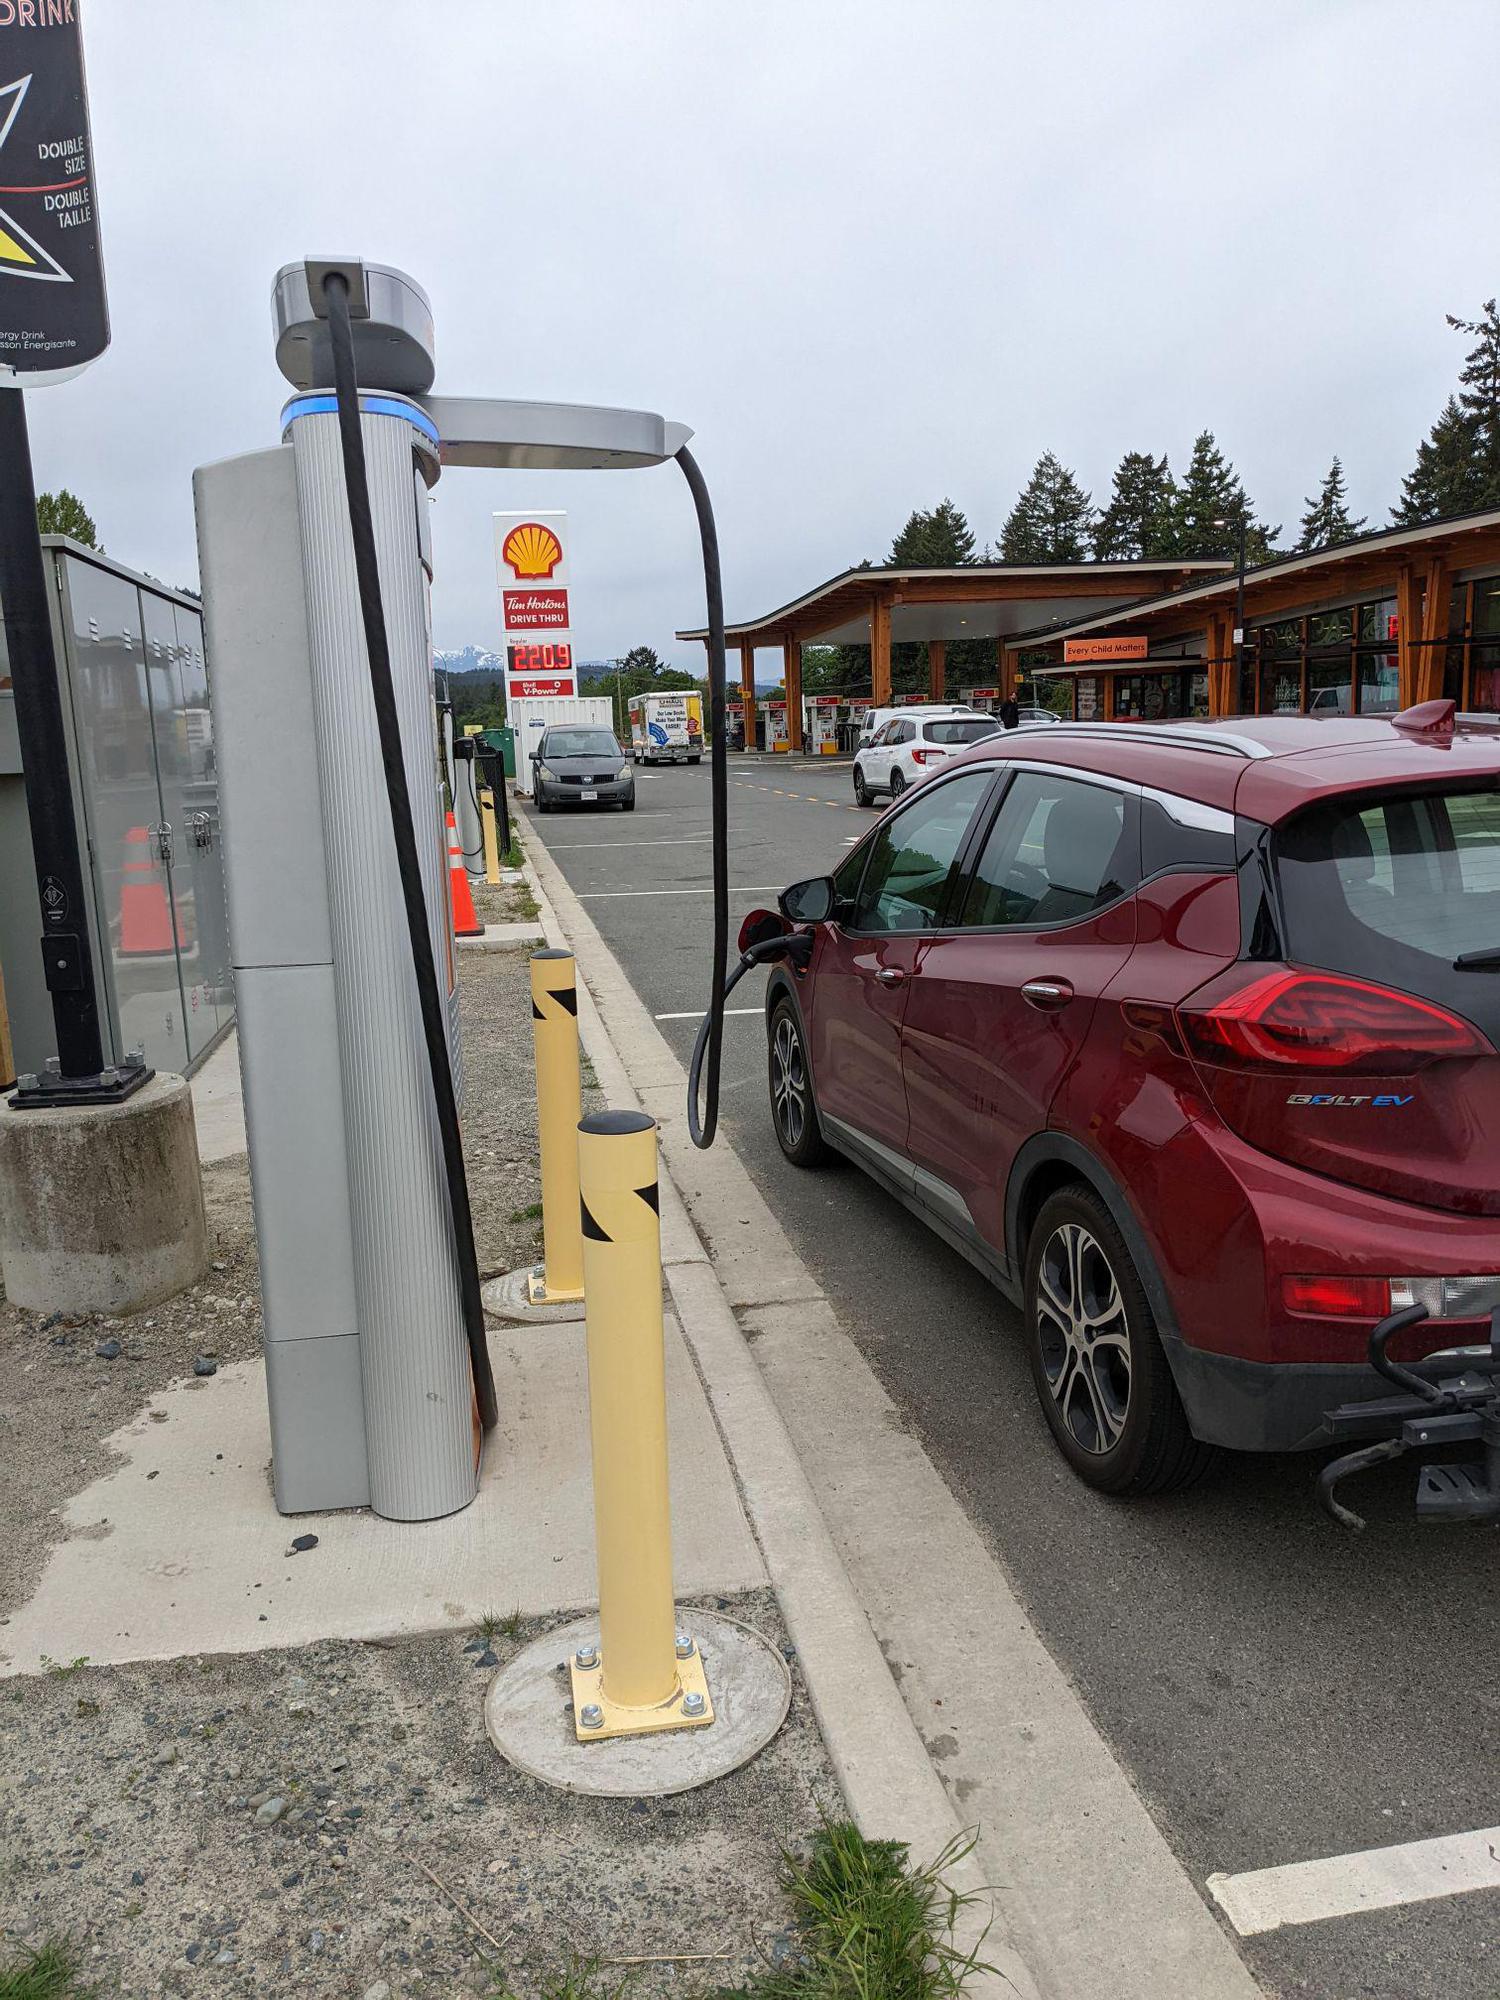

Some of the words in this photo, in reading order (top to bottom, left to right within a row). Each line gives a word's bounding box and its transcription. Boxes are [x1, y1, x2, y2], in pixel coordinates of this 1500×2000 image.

[38, 135, 84, 160] DOUBLE
[65, 155, 86, 175] SIZE
[44, 187, 90, 211] DOUBLE
[57, 206, 91, 229] TAILLE
[21, 331, 46, 340] Drink
[506, 597, 525, 610] Tim
[526, 596, 566, 610] Hortons
[510, 615, 537, 623] DRIVE
[539, 614, 564, 623] THRU
[514, 644, 570, 670] 220.9
[1067, 647, 1090, 656] Every
[1091, 645, 1113, 654] Child
[1114, 643, 1145, 653] Matters
[1286, 1094, 1371, 1106] BOLT
[1372, 1095, 1415, 1106] EV
